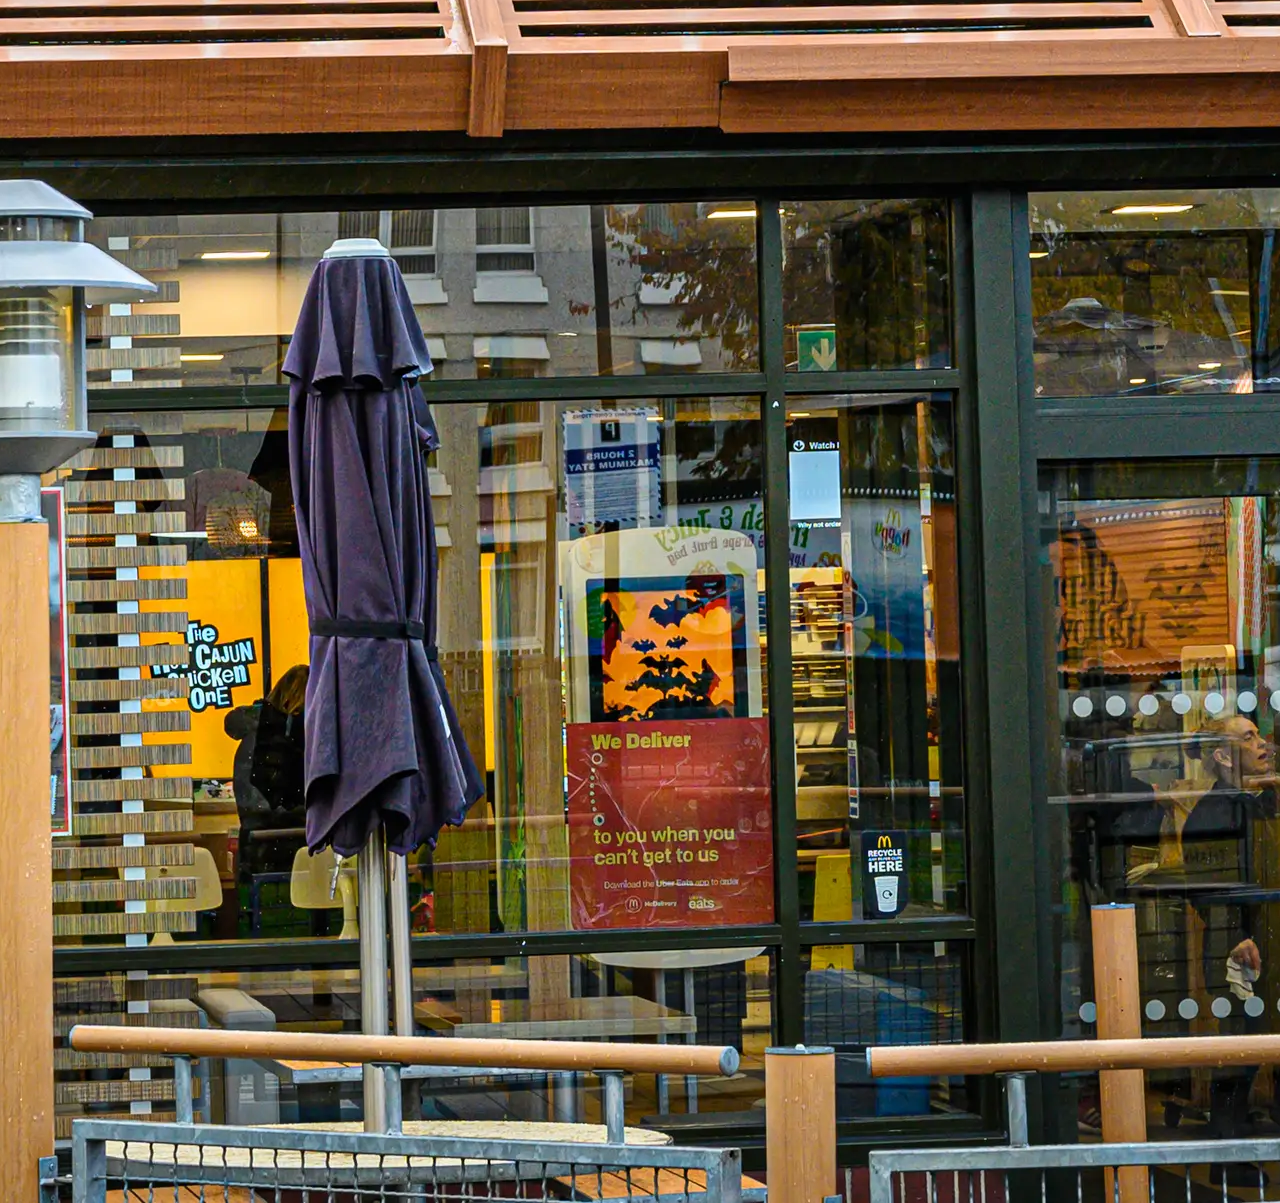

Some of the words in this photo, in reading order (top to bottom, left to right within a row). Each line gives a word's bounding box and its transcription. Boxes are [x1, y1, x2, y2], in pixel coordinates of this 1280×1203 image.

[809, 441, 836, 450] Watch
[797, 521, 812, 529] Why
[591, 734, 622, 750] We
[626, 731, 692, 749] Deliver
[593, 829, 612, 844] to
[616, 829, 648, 846] you
[651, 825, 699, 843] when
[704, 827, 736, 844] you
[594, 848, 639, 866] can't
[643, 848, 672, 867] get
[676, 848, 694, 863] to
[698, 848, 719, 862] us
[867, 848, 903, 858] RECYCLE
[868, 860, 904, 873] HERE
[604, 880, 642, 889] Download
[643, 879, 655, 888] the
[656, 879, 674, 888] Uber
[711, 878, 719, 886] to
[688, 897, 715, 910] eats
